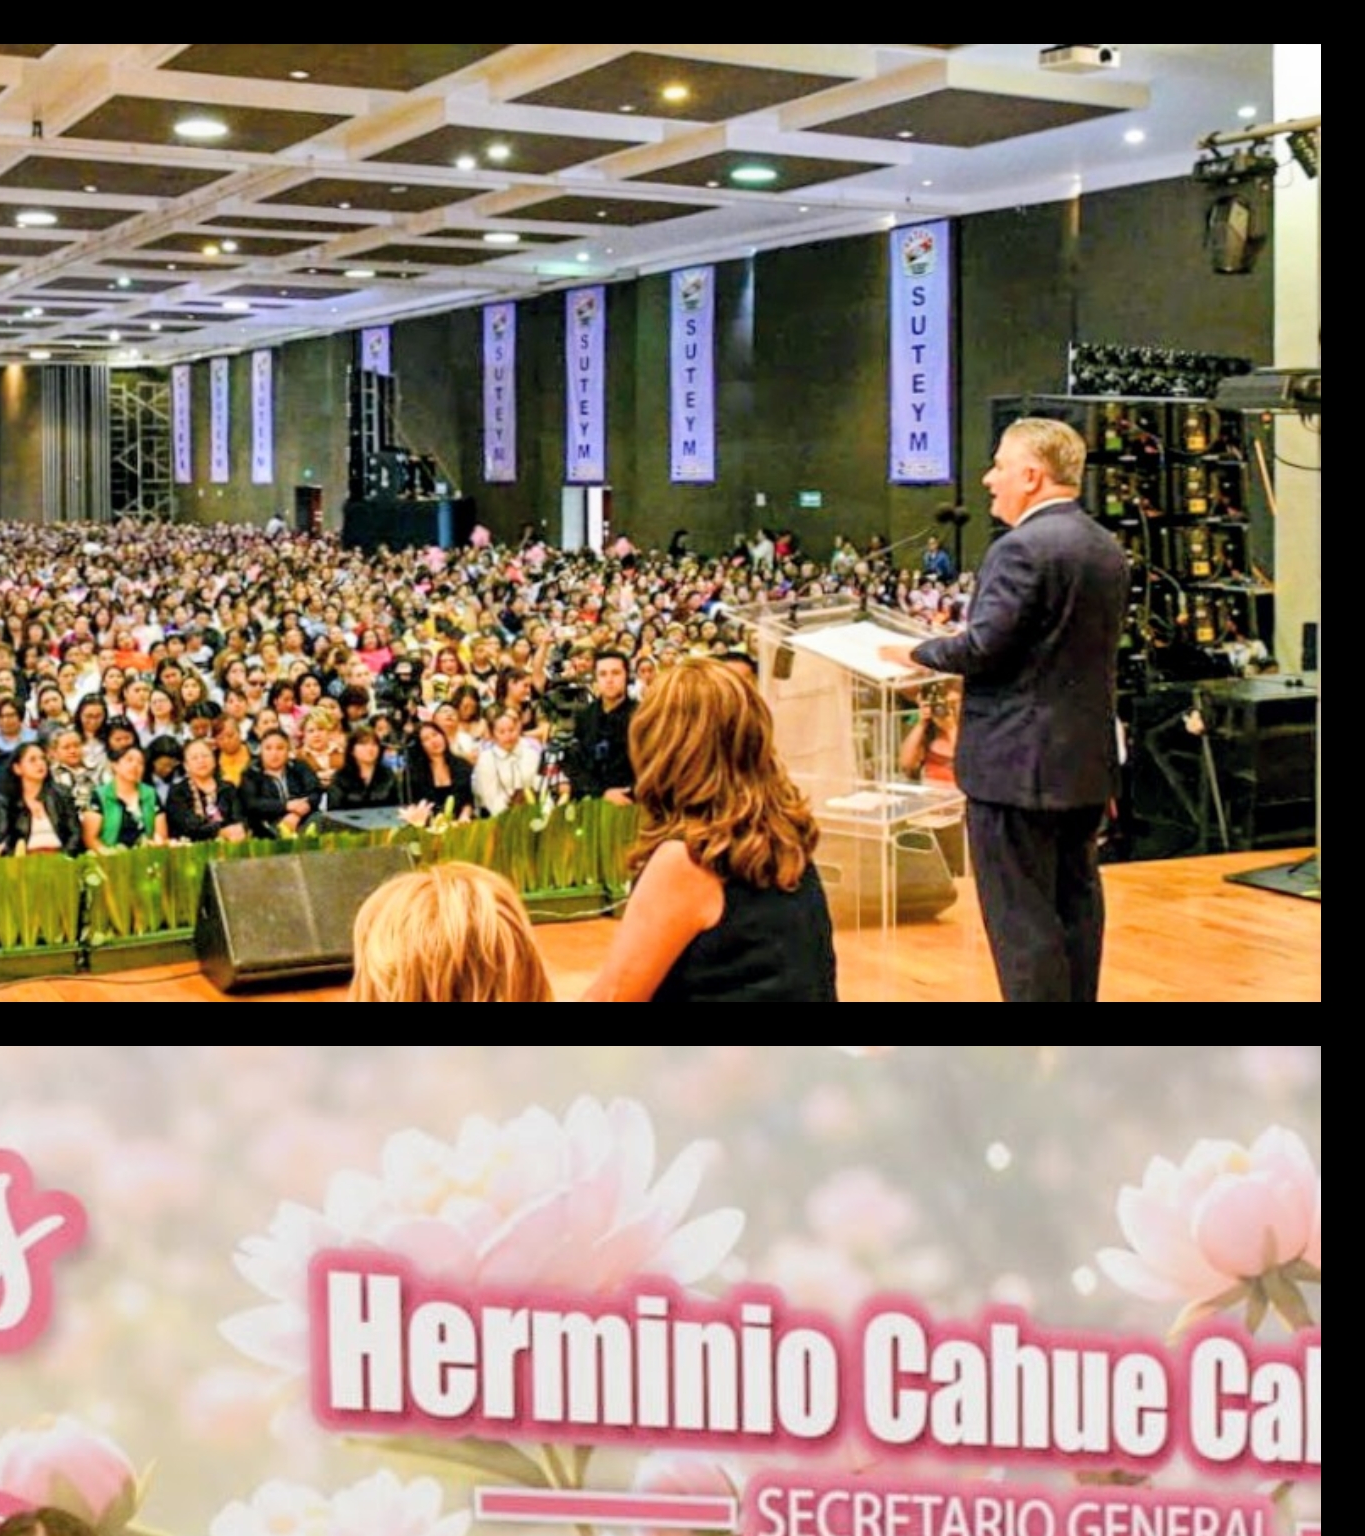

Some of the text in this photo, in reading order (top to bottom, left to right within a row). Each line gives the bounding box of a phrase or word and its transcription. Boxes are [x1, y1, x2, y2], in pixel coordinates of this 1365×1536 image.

[577, 333, 590, 459] SUTEYM
[683, 318, 697, 456] SUTEYM
[909, 284, 928, 452] SUTEYM
[327, 1270, 839, 1438] Herminio
[863, 1312, 1168, 1457] Cahue
